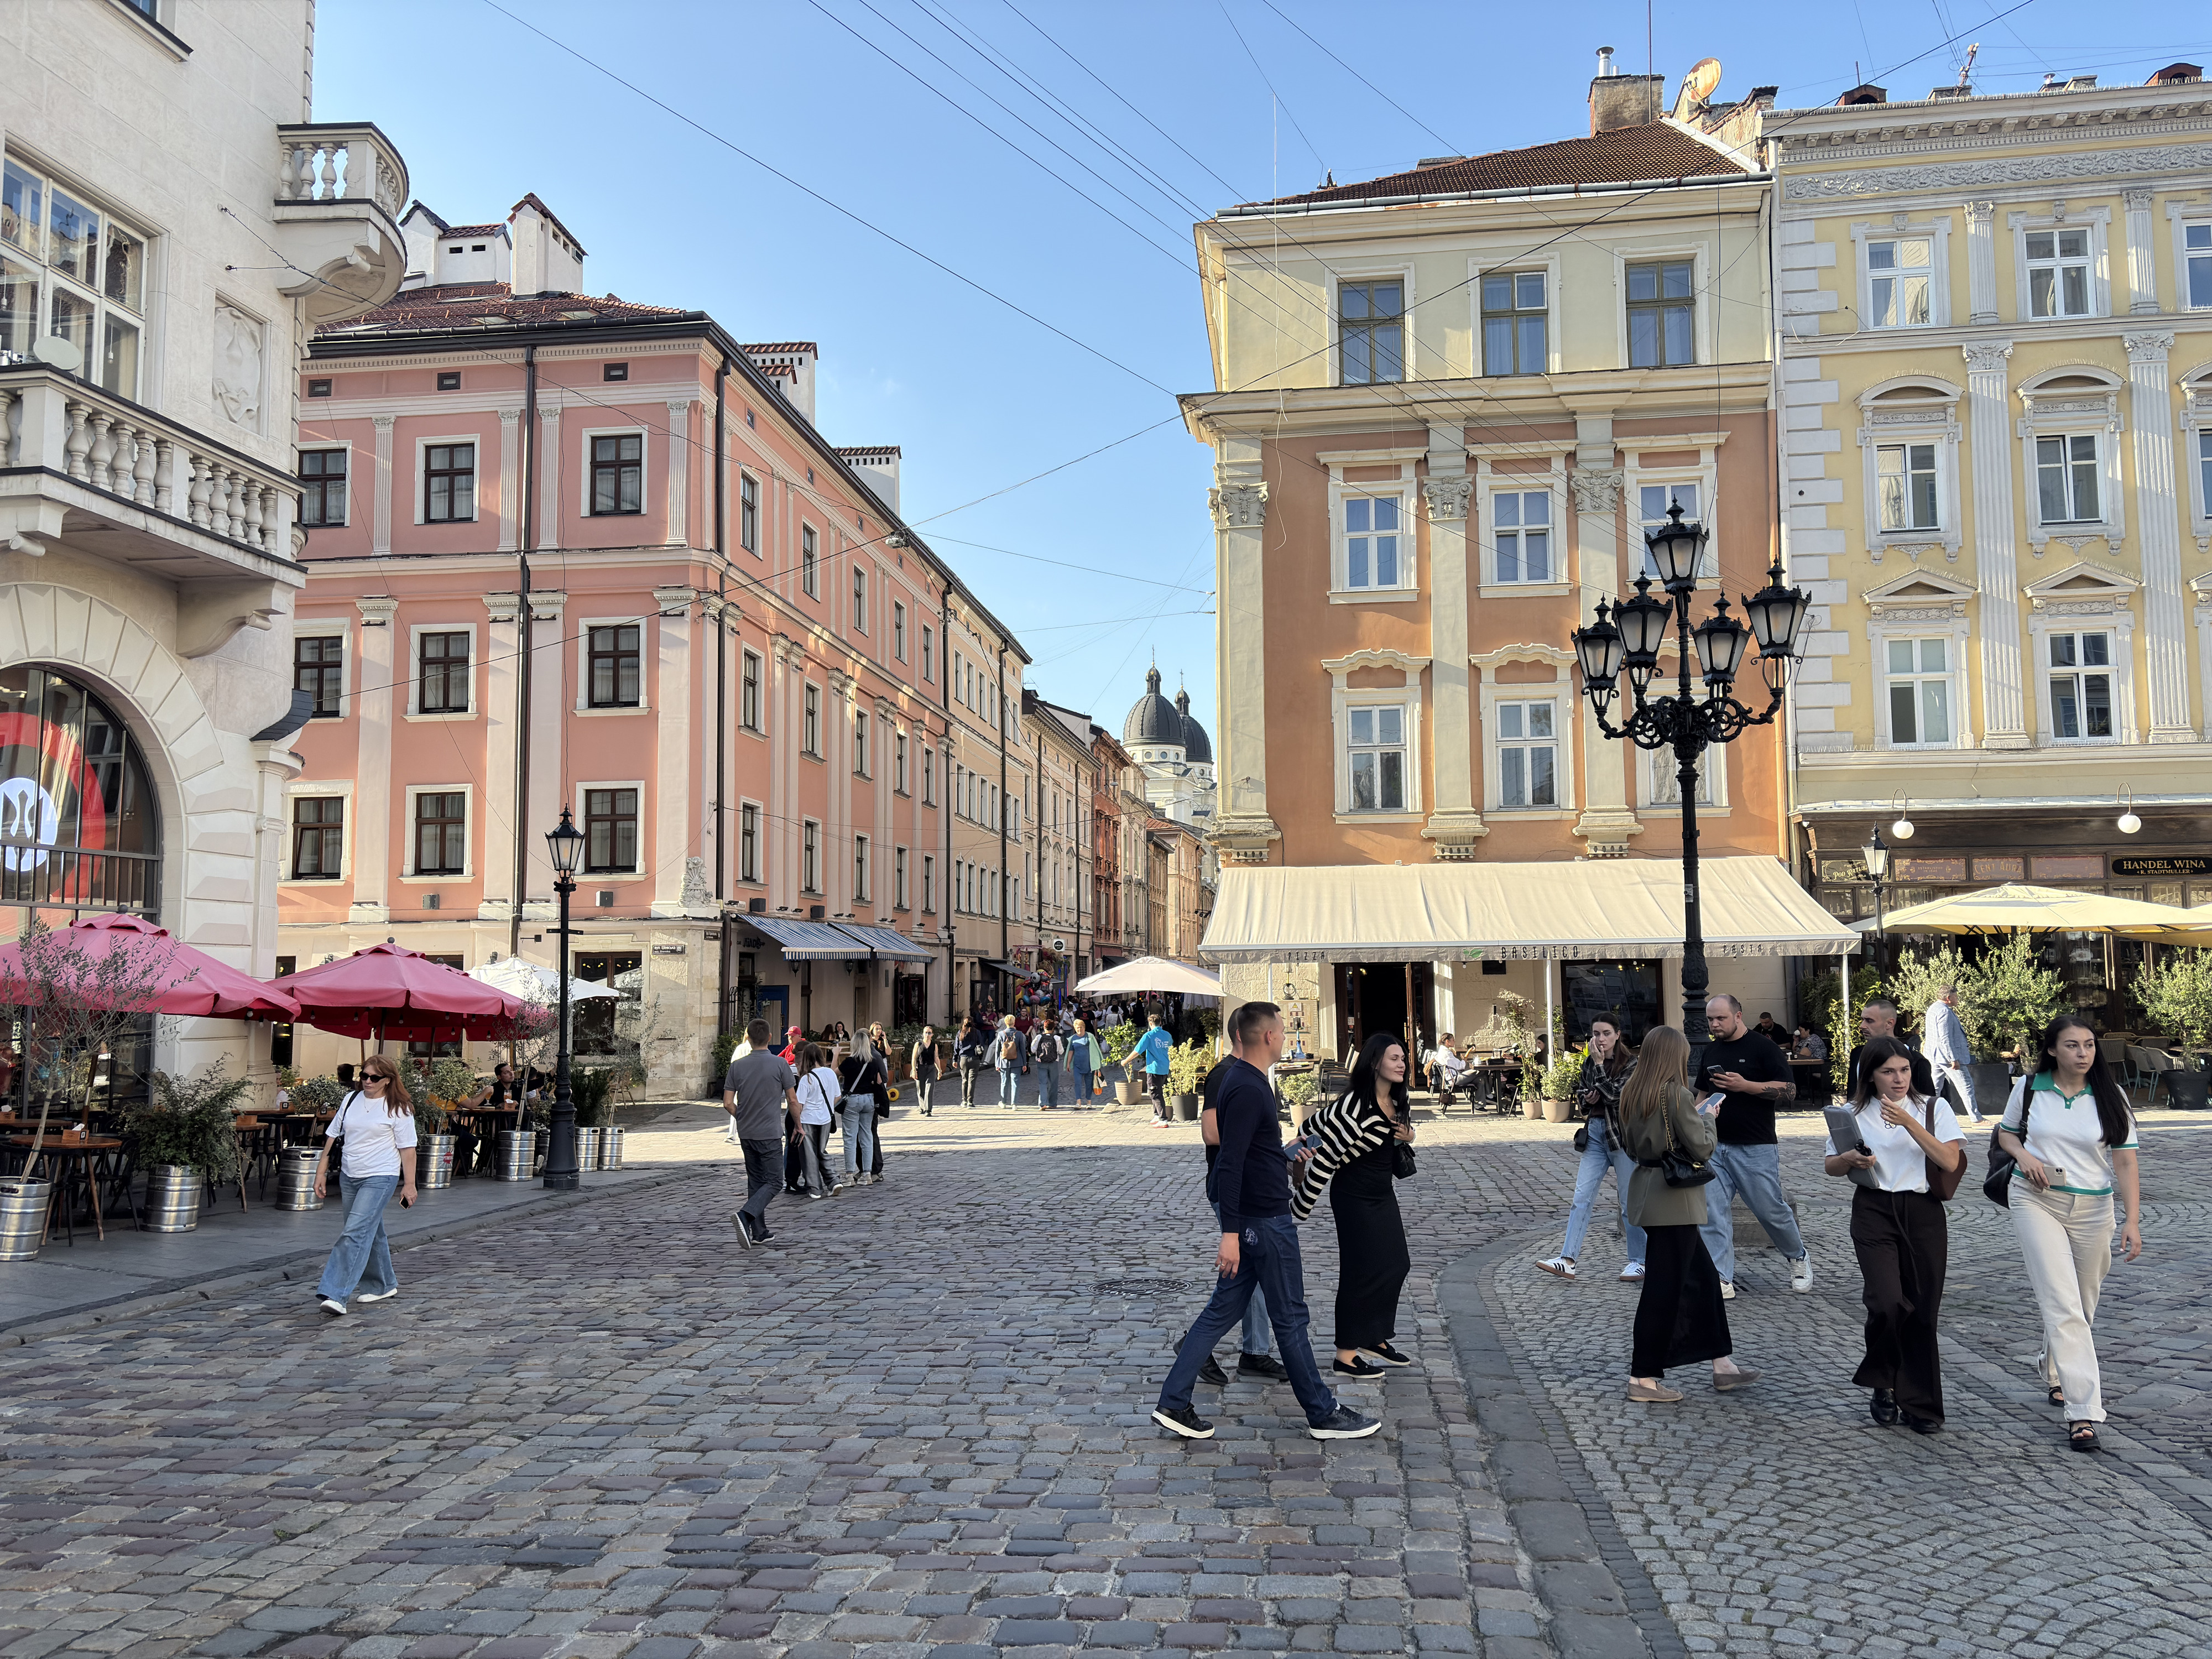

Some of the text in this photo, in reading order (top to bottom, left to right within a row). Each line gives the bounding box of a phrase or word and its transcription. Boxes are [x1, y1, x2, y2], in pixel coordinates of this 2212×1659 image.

[1974, 861, 2022, 874] CENT AURA
[2123, 860, 2206, 869] HANDEL WINA
[1501, 945, 1578, 959] BASILICO
[1723, 944, 1762, 954] PASTA
[1288, 951, 1325, 961] PIZZA
